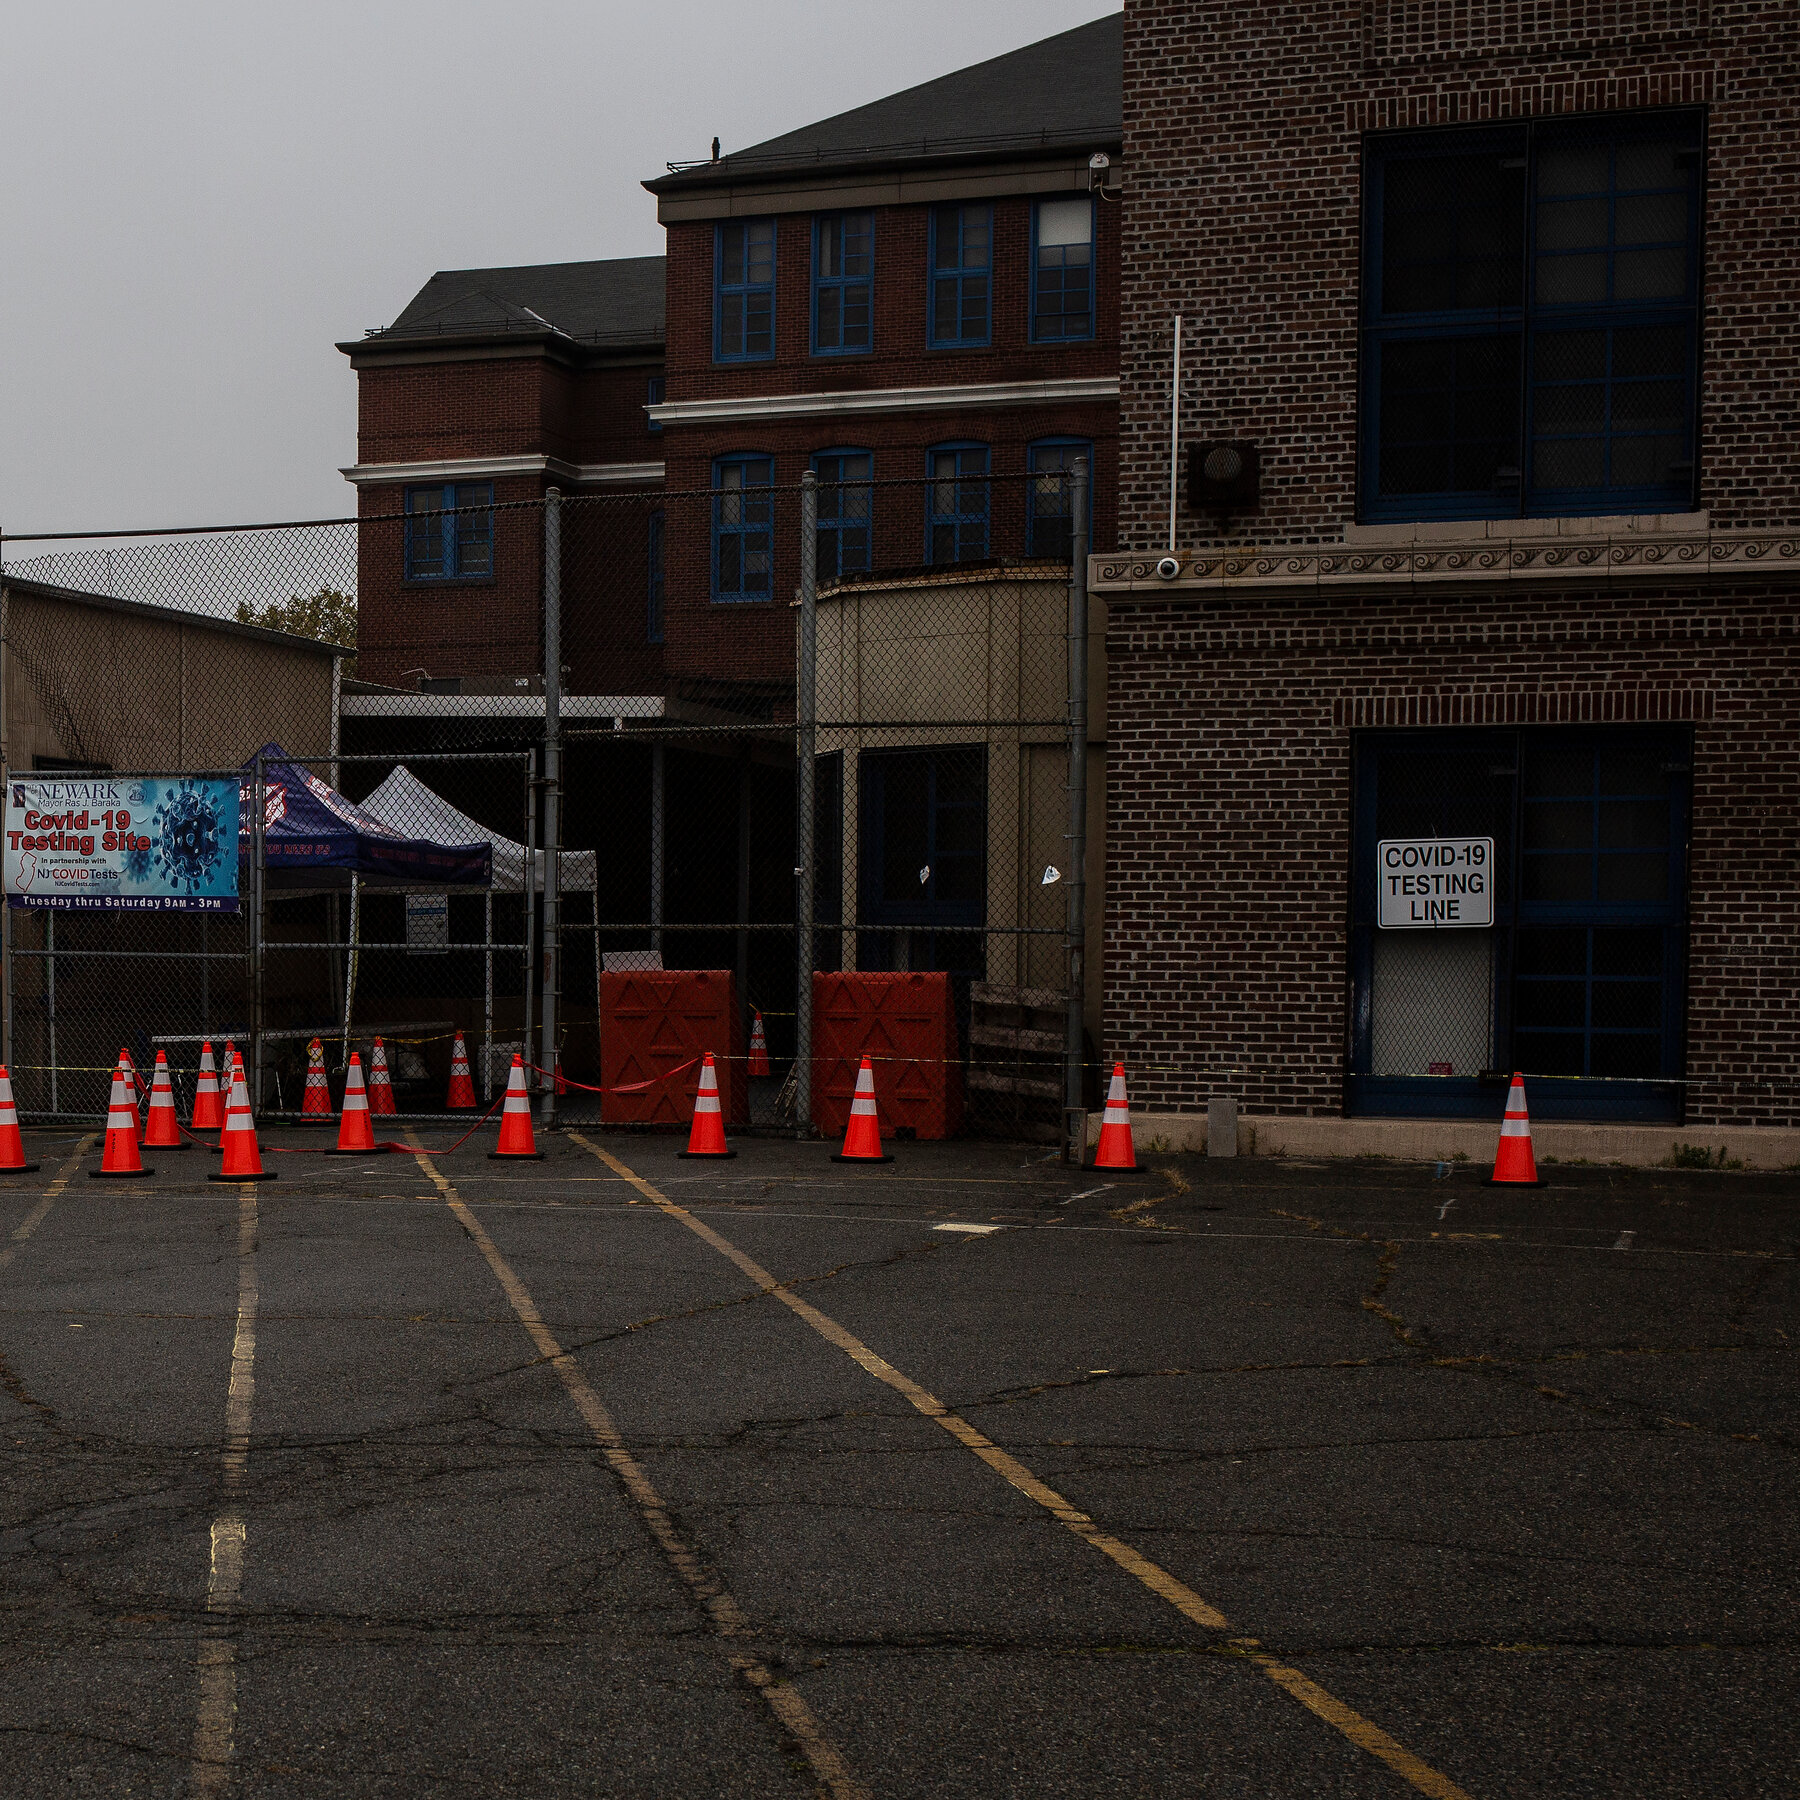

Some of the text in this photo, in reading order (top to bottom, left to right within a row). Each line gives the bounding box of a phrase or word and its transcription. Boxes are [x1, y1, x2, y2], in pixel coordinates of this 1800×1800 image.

[39, 783, 120, 800] NEWARK
[39, 799, 121, 808] Mayor Ras J. Baraka
[24, 809, 131, 831] Covid-19
[7, 829, 152, 856] Testing Site
[50, 857, 89, 866] partnership
[1385, 844, 1486, 868] COVID-19
[37, 868, 50, 879] NJ
[1387, 872, 1484, 896] TESTING
[22, 895, 72, 908] Tuesday
[75, 896, 101, 907] thru
[104, 896, 161, 909] Saturday
[164, 898, 187, 908] 9AM
[198, 898, 221, 909] 3PM
[1410, 899, 1460, 921] LINE
